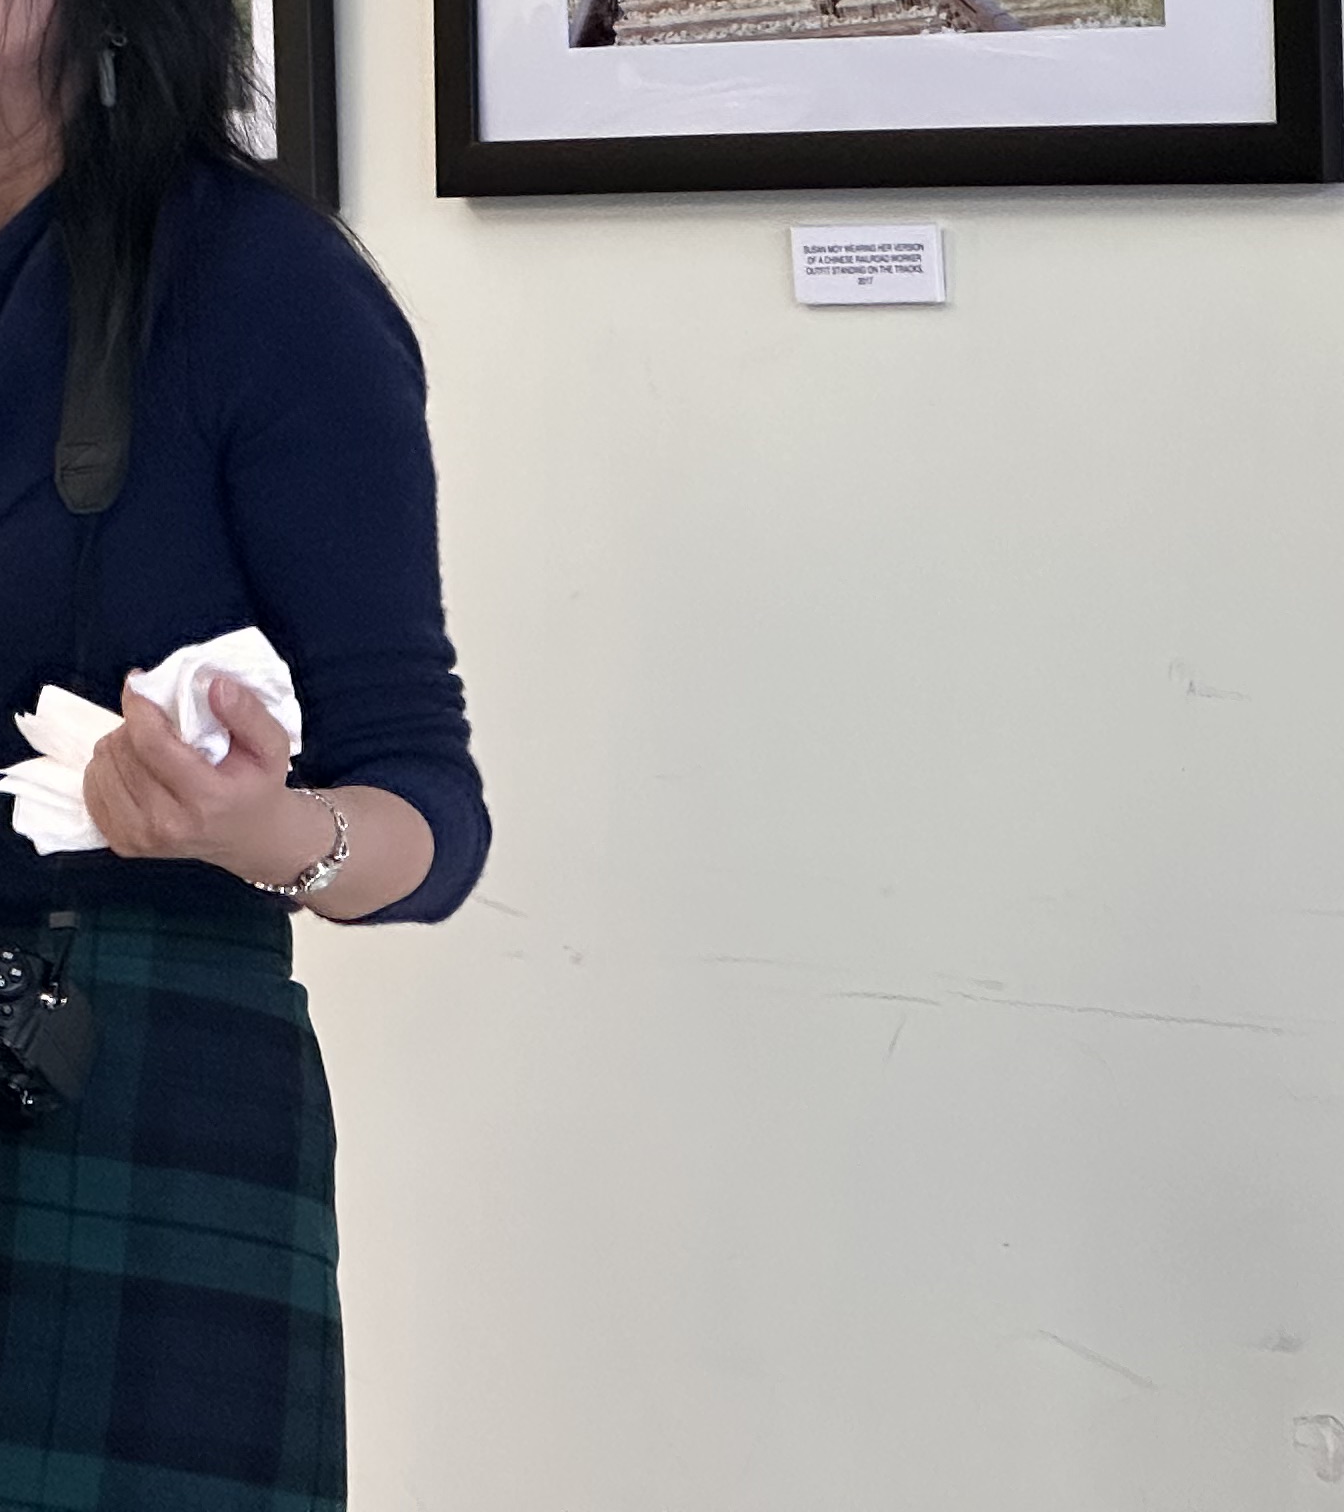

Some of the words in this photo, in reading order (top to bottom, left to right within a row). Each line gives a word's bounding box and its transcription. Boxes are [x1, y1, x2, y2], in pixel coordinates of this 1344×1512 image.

[878, 244, 892, 252] HER
[894, 243, 924, 252] VERSION
[807, 256, 816, 264] OF
[824, 255, 853, 264] CHINESE
[856, 255, 889, 263] RAILROAD
[891, 254, 922, 262] WORKER
[806, 266, 830, 275] OUTFIT
[832, 266, 866, 275] STANDING
[868, 266, 878, 274] ON
[880, 265, 893, 273] THE
